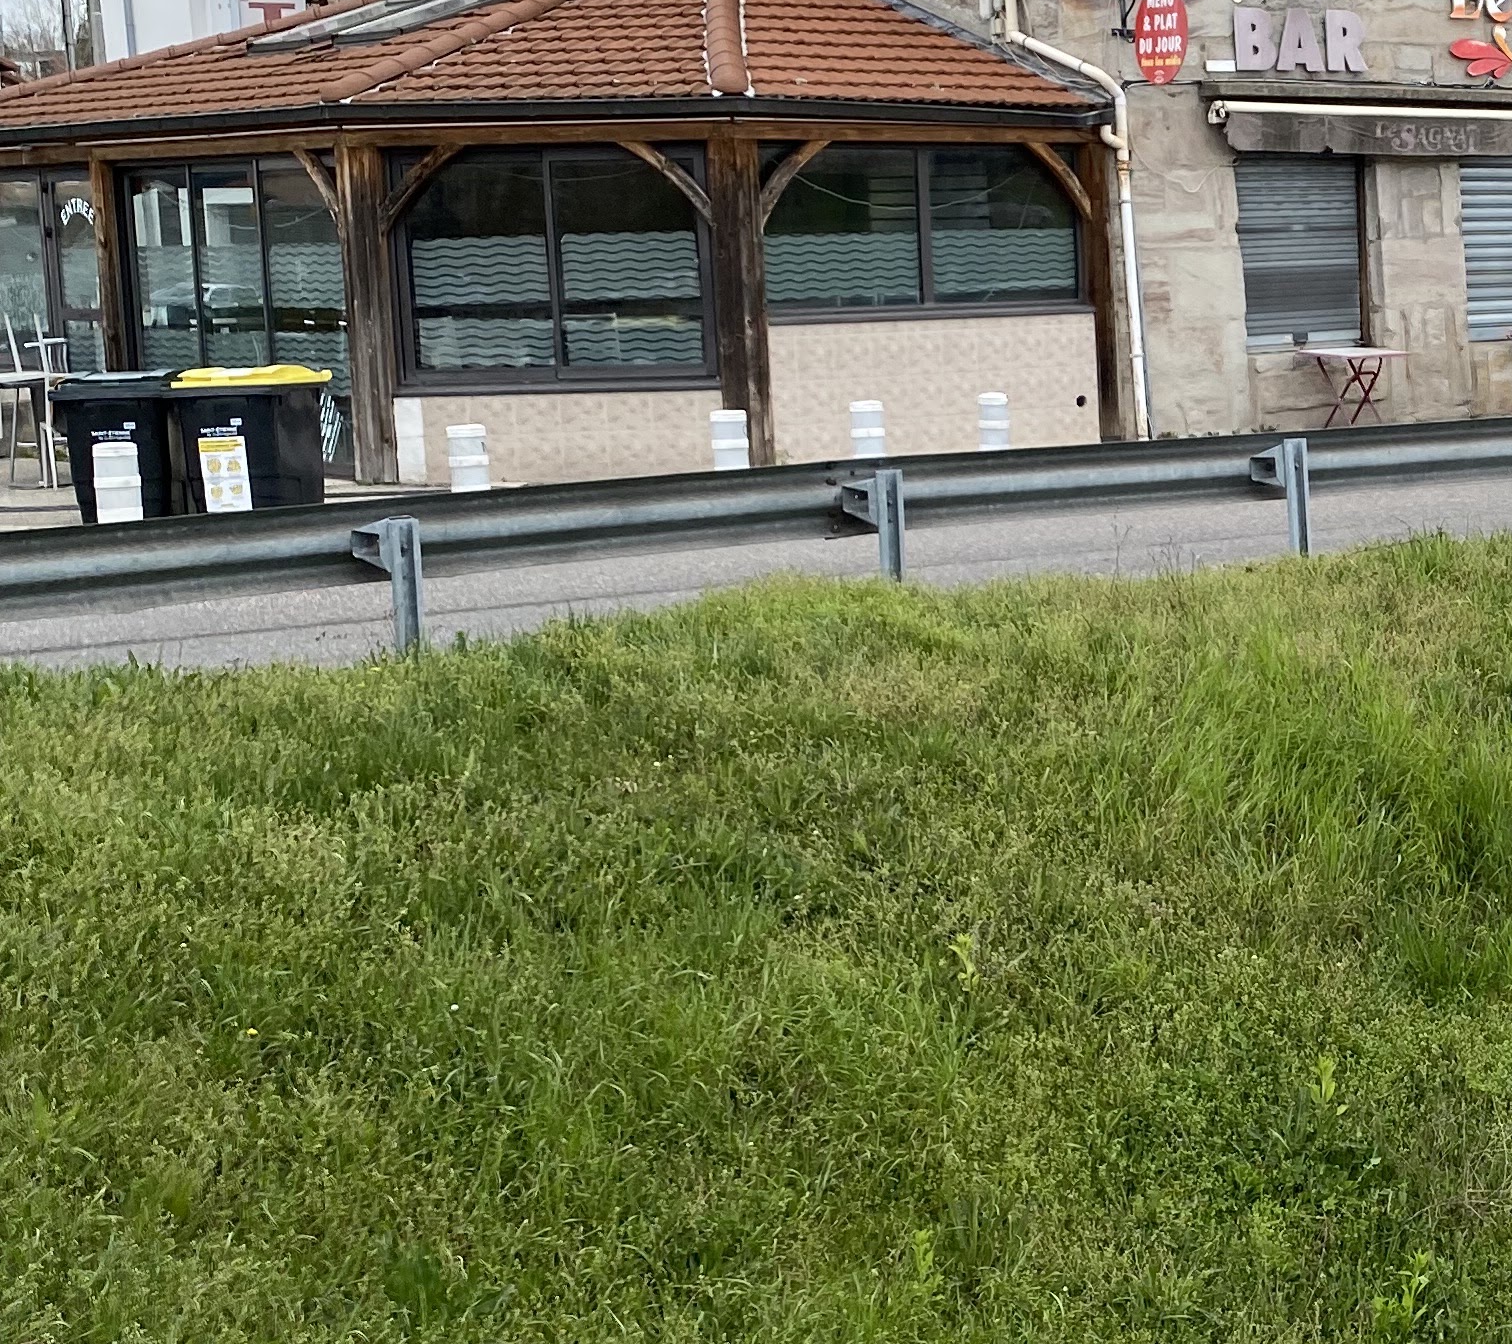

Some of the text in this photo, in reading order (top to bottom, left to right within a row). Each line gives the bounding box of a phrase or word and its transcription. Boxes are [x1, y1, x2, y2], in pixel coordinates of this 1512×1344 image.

[1143, 12, 1178, 32] & PLAT
[1139, 35, 1182, 54] DU JOUR
[1233, 7, 1369, 73] BAR
